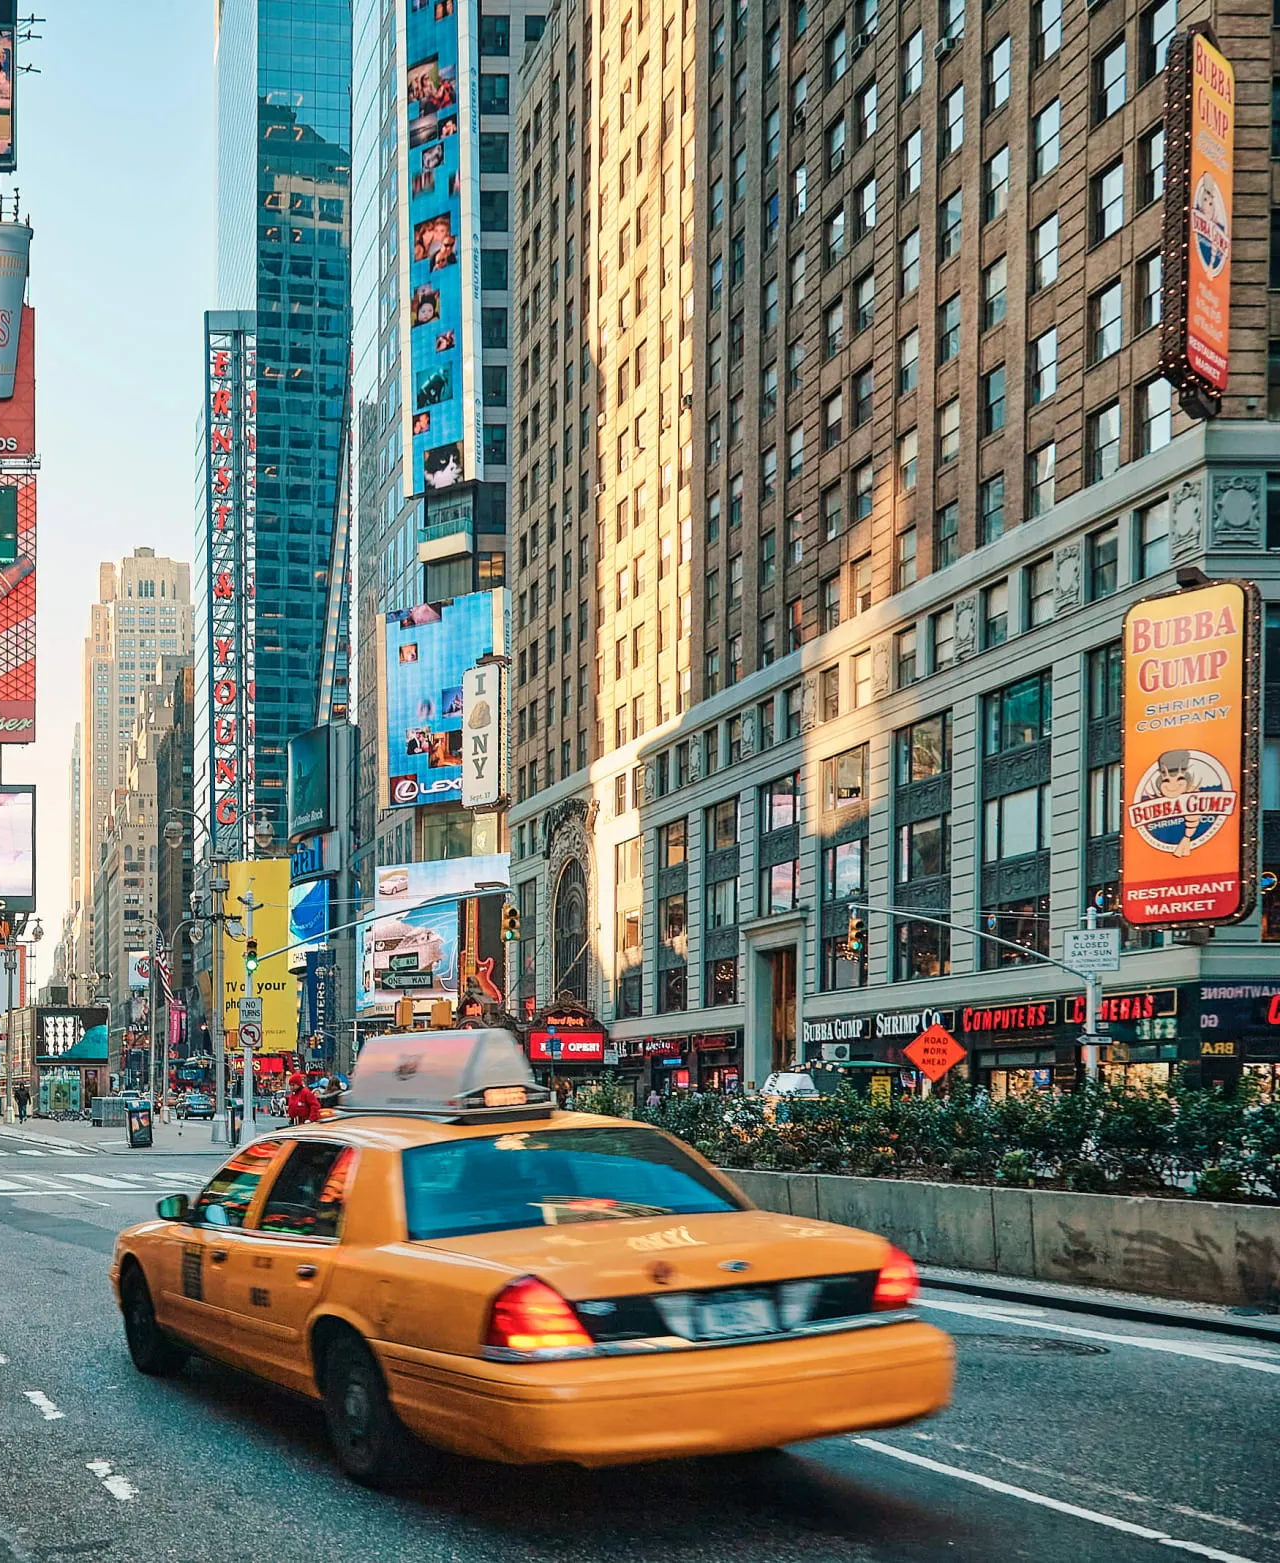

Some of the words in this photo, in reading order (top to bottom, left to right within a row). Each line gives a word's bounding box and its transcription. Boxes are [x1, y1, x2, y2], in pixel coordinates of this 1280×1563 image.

[1196, 41, 1233, 105] BUBBA
[1198, 86, 1229, 140] GUMP
[211, 352, 232, 530] ERNST
[213, 572, 233, 598] &
[1131, 606, 1237, 655] BUBBA
[1138, 650, 1228, 693] GUMP
[1145, 693, 1220, 716] SHRIMP
[1136, 705, 1232, 733] COMPANY
[214, 638, 236, 826] YOUNG
[1133, 801, 1182, 824] BUBBA
[1186, 795, 1232, 813] GUMP
[1147, 817, 1184, 831] SHRIMP
[1127, 881, 1236, 901] RESTAURANT
[1145, 899, 1216, 916] MARKET
[225, 981, 237, 992] TV
[257, 981, 287, 993] your
[241, 1009, 261, 1017] TURNS
[547, 1016, 566, 1025] Hard
[876, 1013, 920, 1037] SHRIMP
[963, 1004, 1047, 1032] COMPUTERS
[803, 1022, 834, 1043] BUBBA
[834, 1019, 863, 1040] GUMP
[924, 1036, 949, 1045] ROAD
[568, 1042, 600, 1052] OPEN!
[923, 1047, 948, 1056] WORK
[922, 1058, 947, 1066] AHEAD
